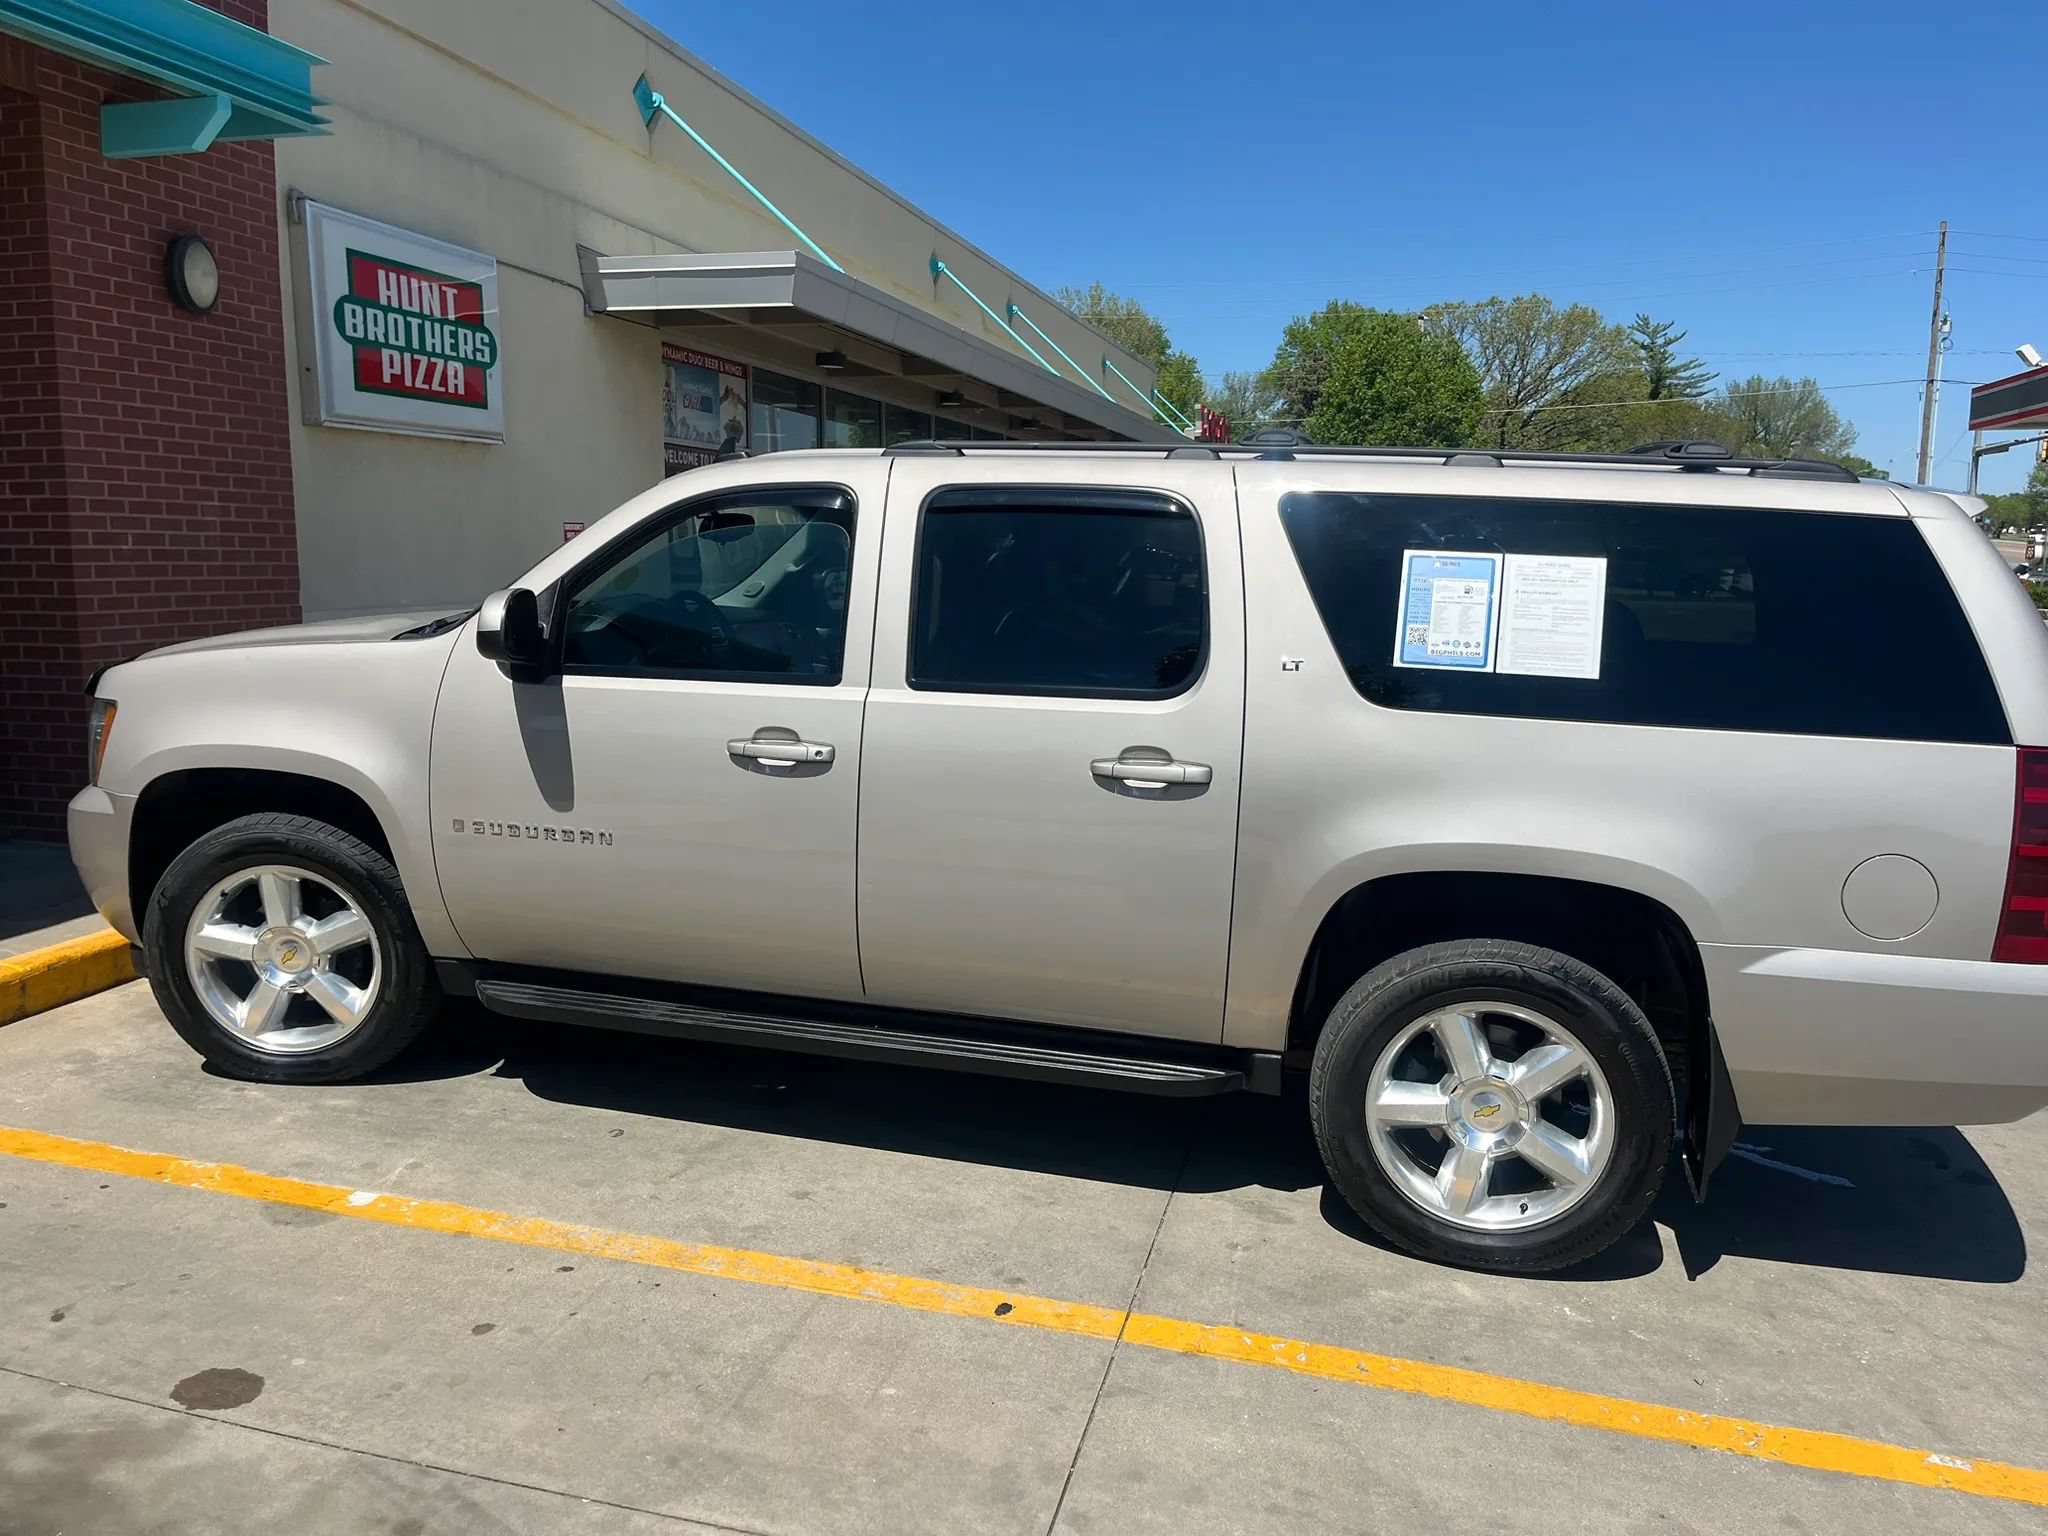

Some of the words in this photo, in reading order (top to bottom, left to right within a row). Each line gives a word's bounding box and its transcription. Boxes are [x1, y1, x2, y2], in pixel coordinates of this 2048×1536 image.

[377, 269, 458, 321] HUNT
[343, 302, 491, 363] BROTHERS
[381, 348, 465, 395] PIZZA
[663, 346, 688, 362] YNAMIC
[705, 357, 719, 370] BEER
[724, 362, 743, 376] WINGS
[1282, 656, 1305, 672] LT
[472, 819, 613, 846] SUBURBAN
